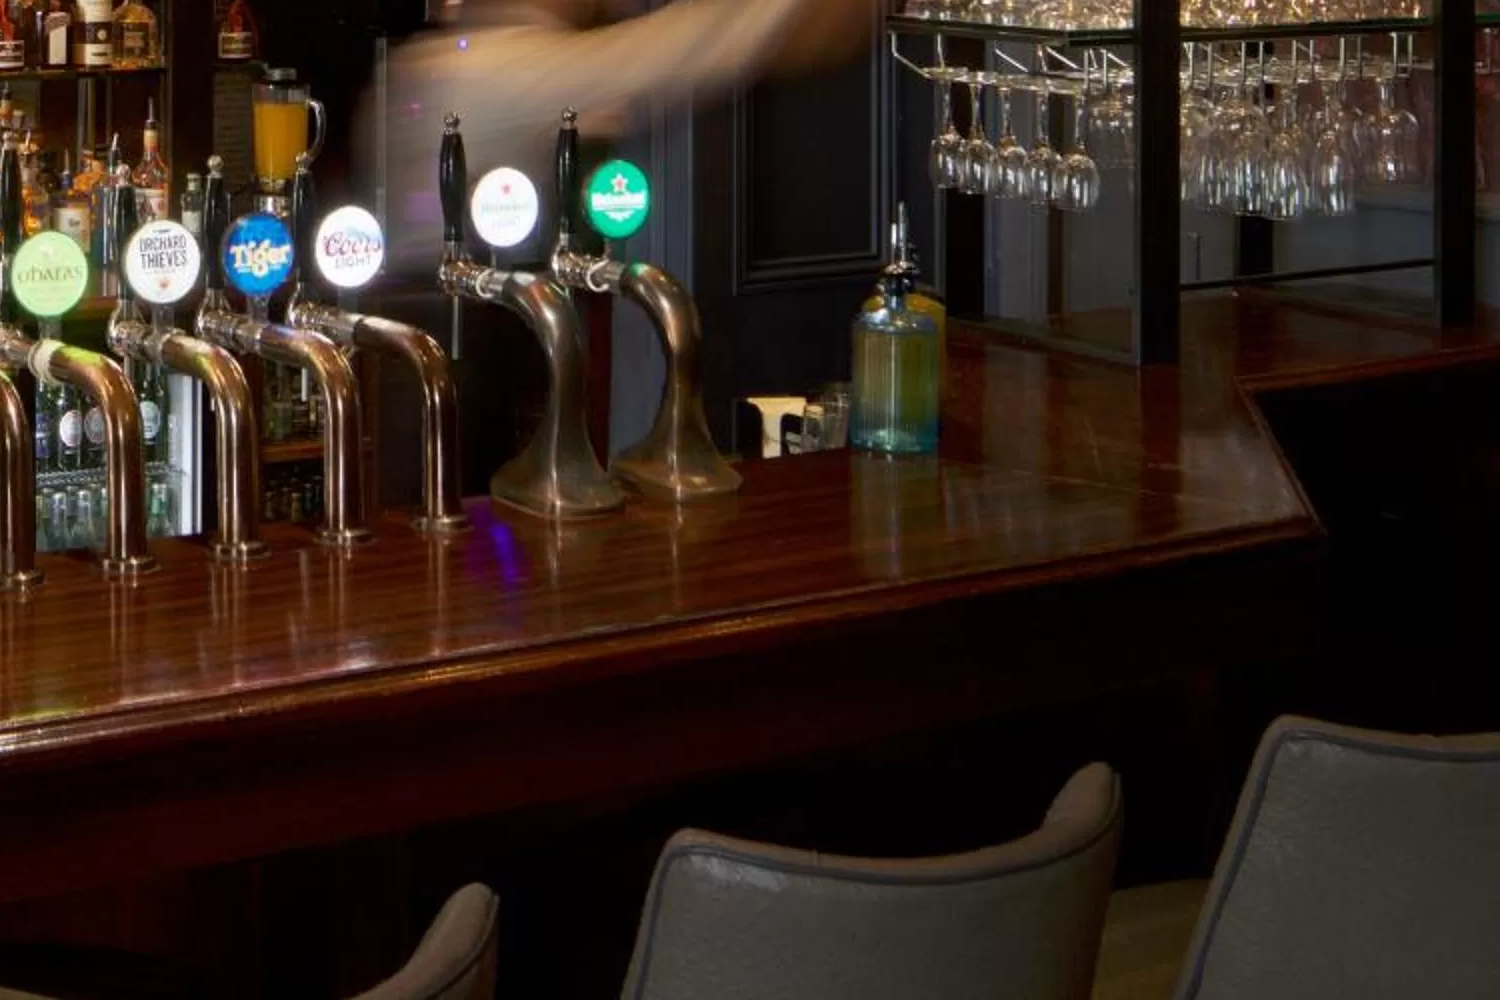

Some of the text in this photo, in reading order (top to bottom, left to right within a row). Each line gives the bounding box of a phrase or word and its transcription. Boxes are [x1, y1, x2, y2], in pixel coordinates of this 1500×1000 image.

[139, 235, 187, 252] ORCHARD
[323, 232, 382, 257] Coors
[140, 251, 188, 270] THIEVES
[229, 239, 291, 277] Tiger
[336, 256, 372, 269] LIGHT
